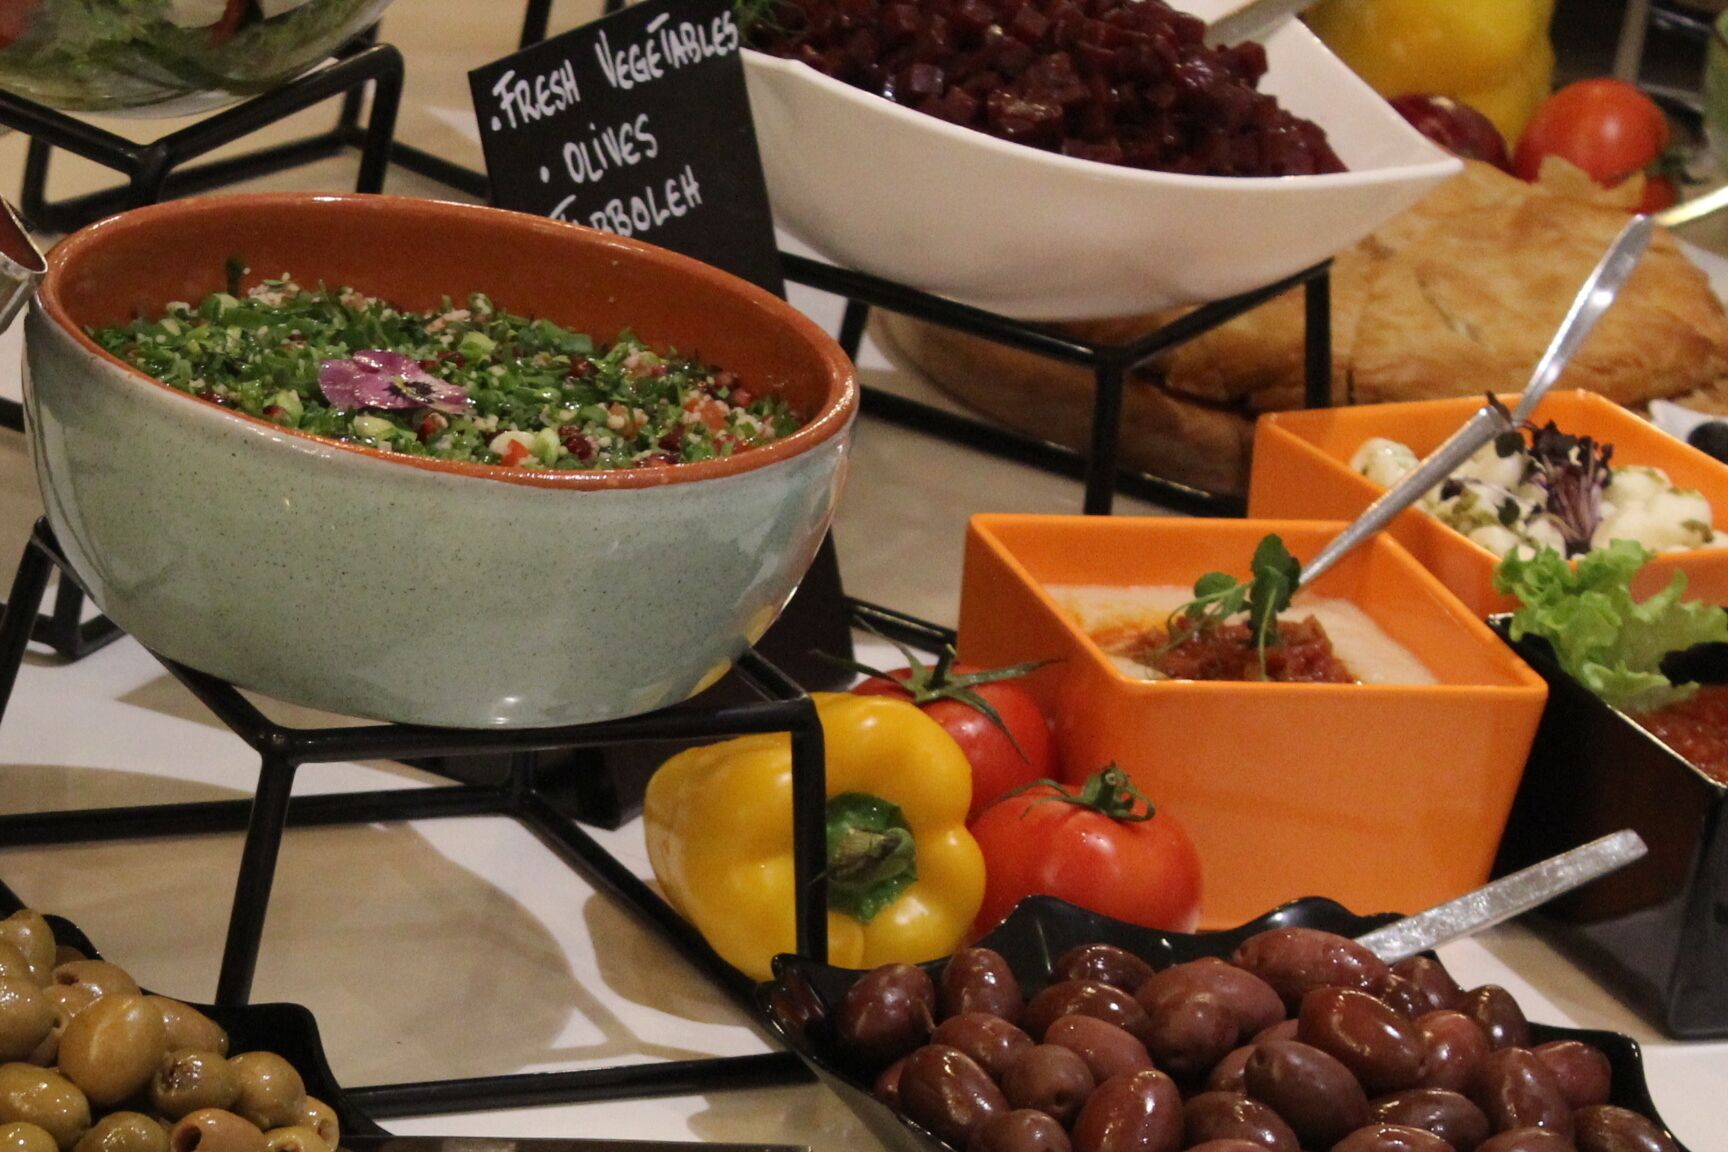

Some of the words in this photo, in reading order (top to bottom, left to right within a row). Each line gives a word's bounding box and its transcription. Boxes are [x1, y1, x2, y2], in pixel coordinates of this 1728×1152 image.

[492, 60, 581, 129] FRESH
[594, 10, 739, 90] VEGETABLES
[550, 165, 703, 237] BBOLEH
